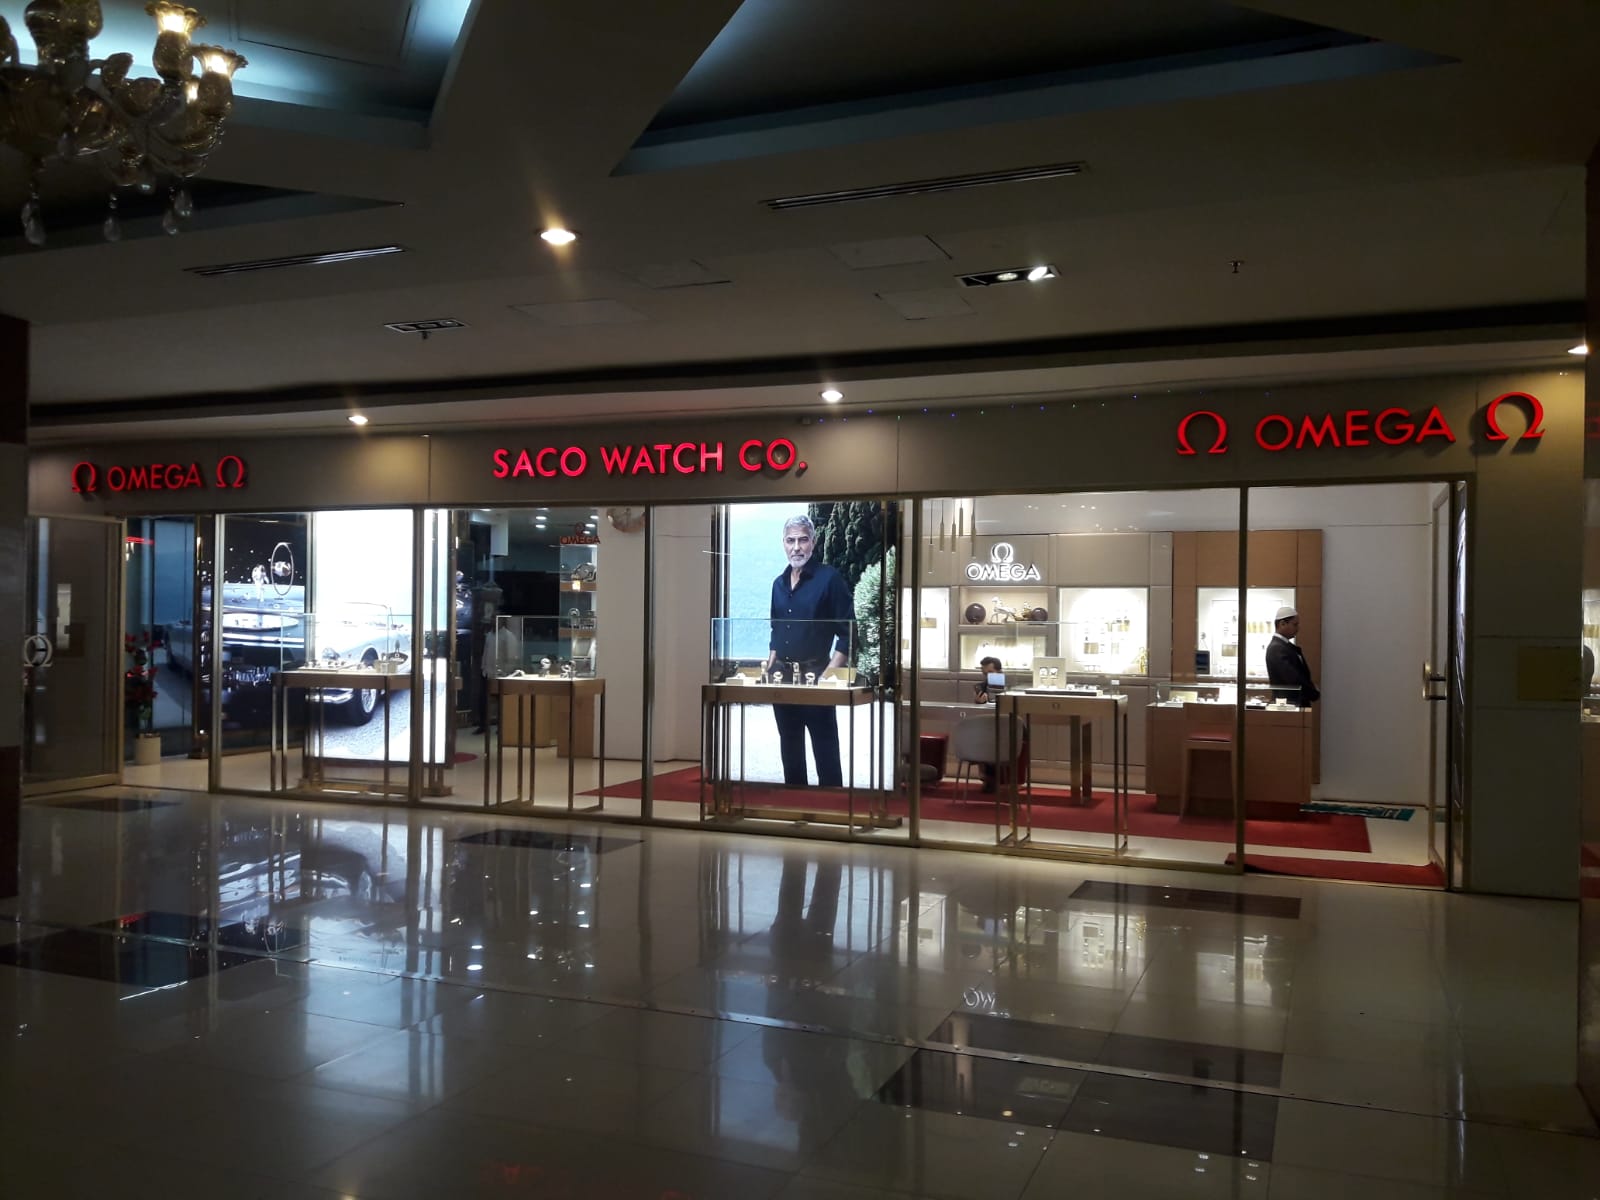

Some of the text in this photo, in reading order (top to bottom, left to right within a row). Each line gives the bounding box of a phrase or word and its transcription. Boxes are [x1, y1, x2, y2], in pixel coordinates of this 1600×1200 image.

[1254, 407, 1457, 452] OMEGA
[492, 437, 807, 479] SACO WATCH CO.
[106, 463, 203, 491] OMEGA
[560, 535, 601, 545] OMEGA
[966, 562, 1041, 582] OMEGA
